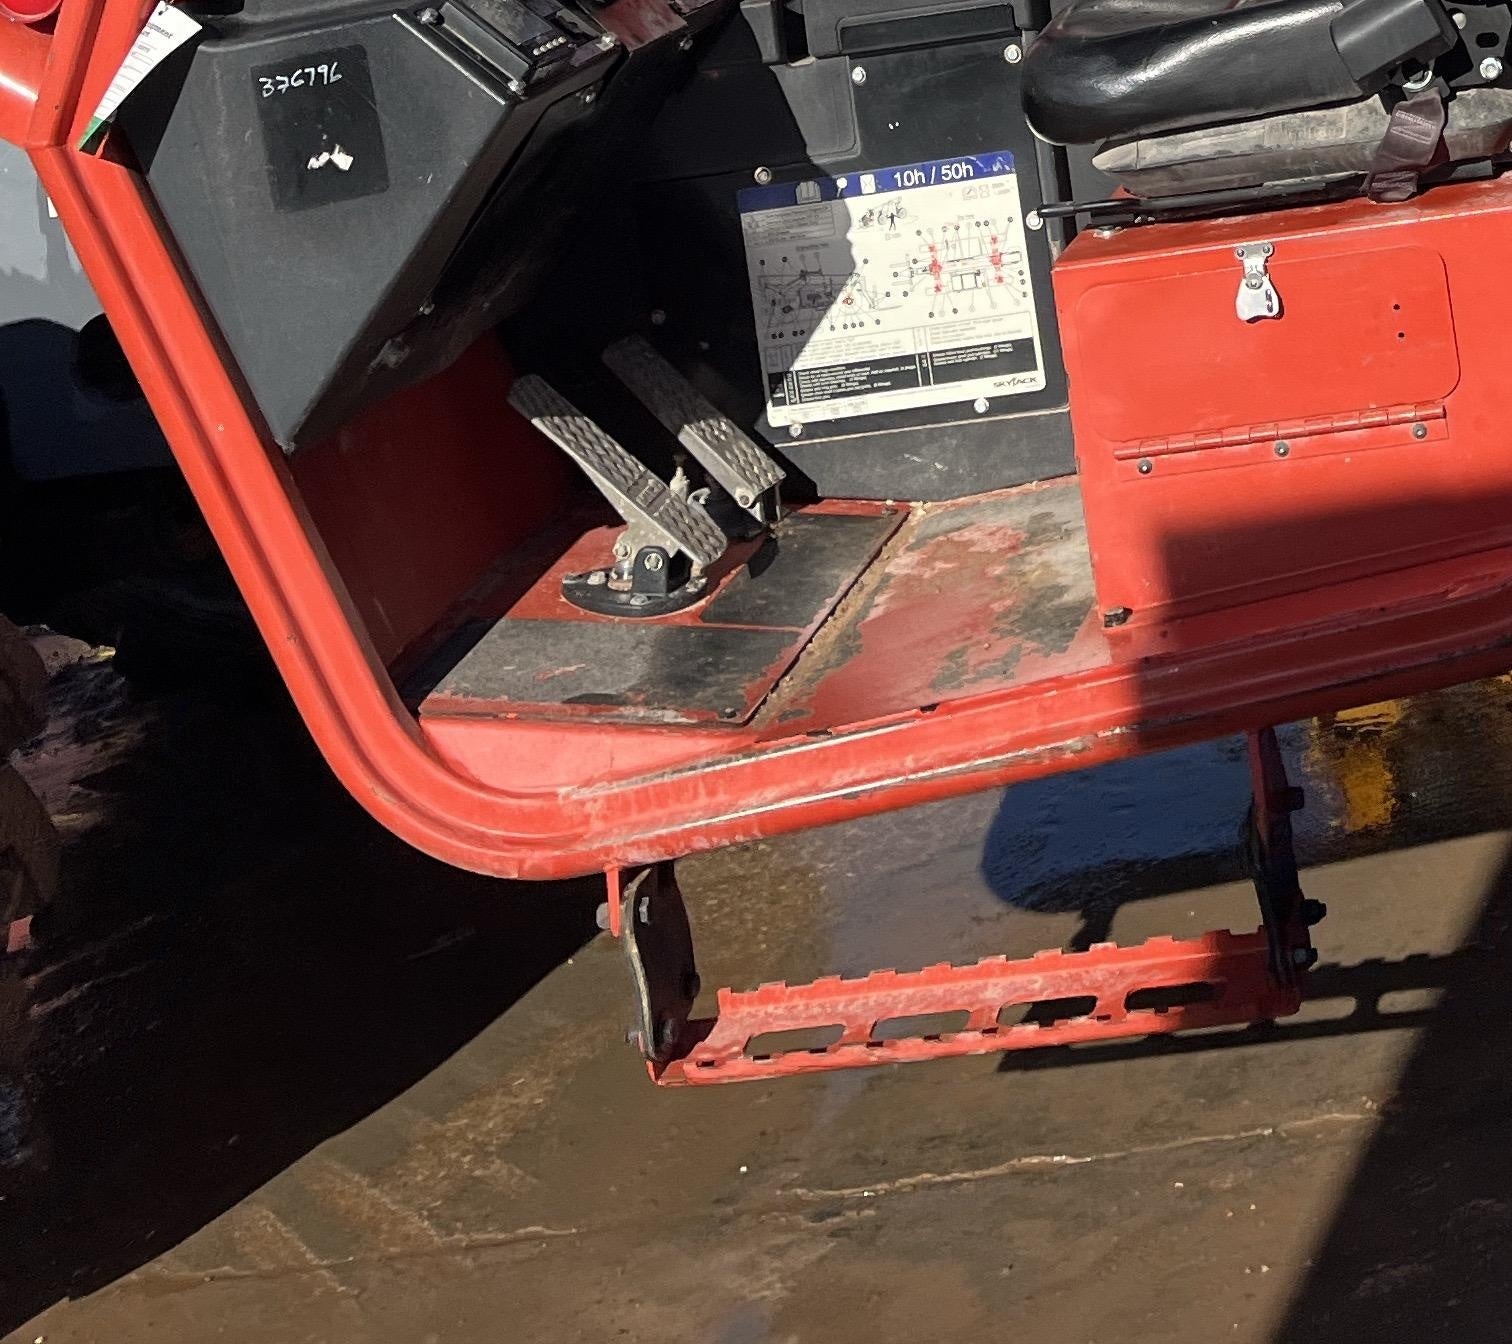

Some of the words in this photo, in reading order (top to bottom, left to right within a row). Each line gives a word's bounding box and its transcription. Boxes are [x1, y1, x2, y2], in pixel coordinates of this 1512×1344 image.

[258, 61, 343, 98] 376796
[893, 168, 926, 188] 10h
[930, 165, 936, 184] /
[941, 161, 974, 181] 50h
